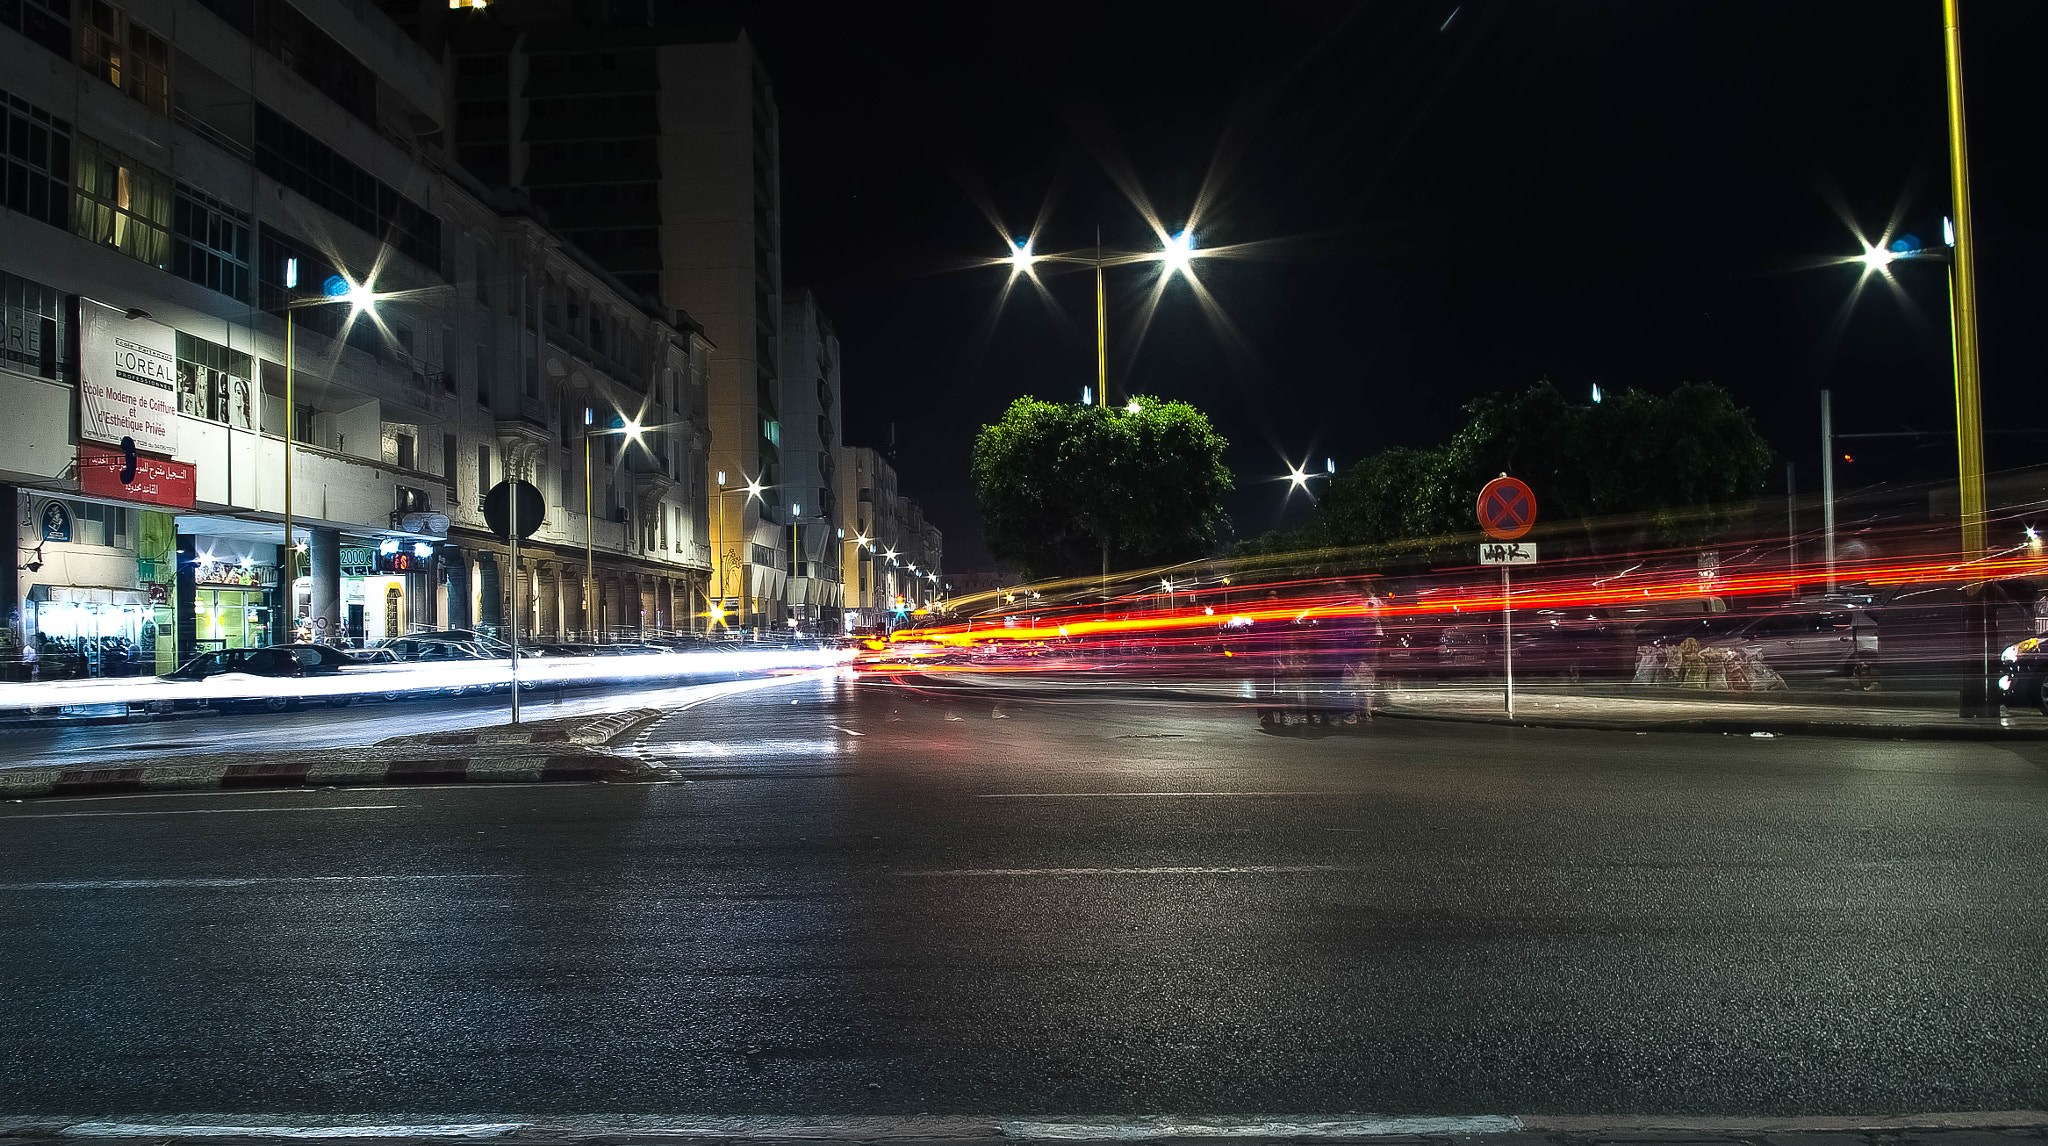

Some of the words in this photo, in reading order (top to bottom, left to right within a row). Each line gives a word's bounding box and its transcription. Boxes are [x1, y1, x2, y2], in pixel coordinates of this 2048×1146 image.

[115, 351, 174, 382] L'ORÉAL
[117, 371, 173, 391] PROFESSIONNEL
[106, 386, 137, 406] Moderne
[139, 396, 148, 409] de
[149, 398, 176, 416] Coiffure
[129, 407, 137, 418] et
[98, 410, 143, 433] d'Esthétique
[145, 420, 166, 437] Privée
[149, 465, 165, 480] مفتوح
[341, 550, 365, 564] 2000
